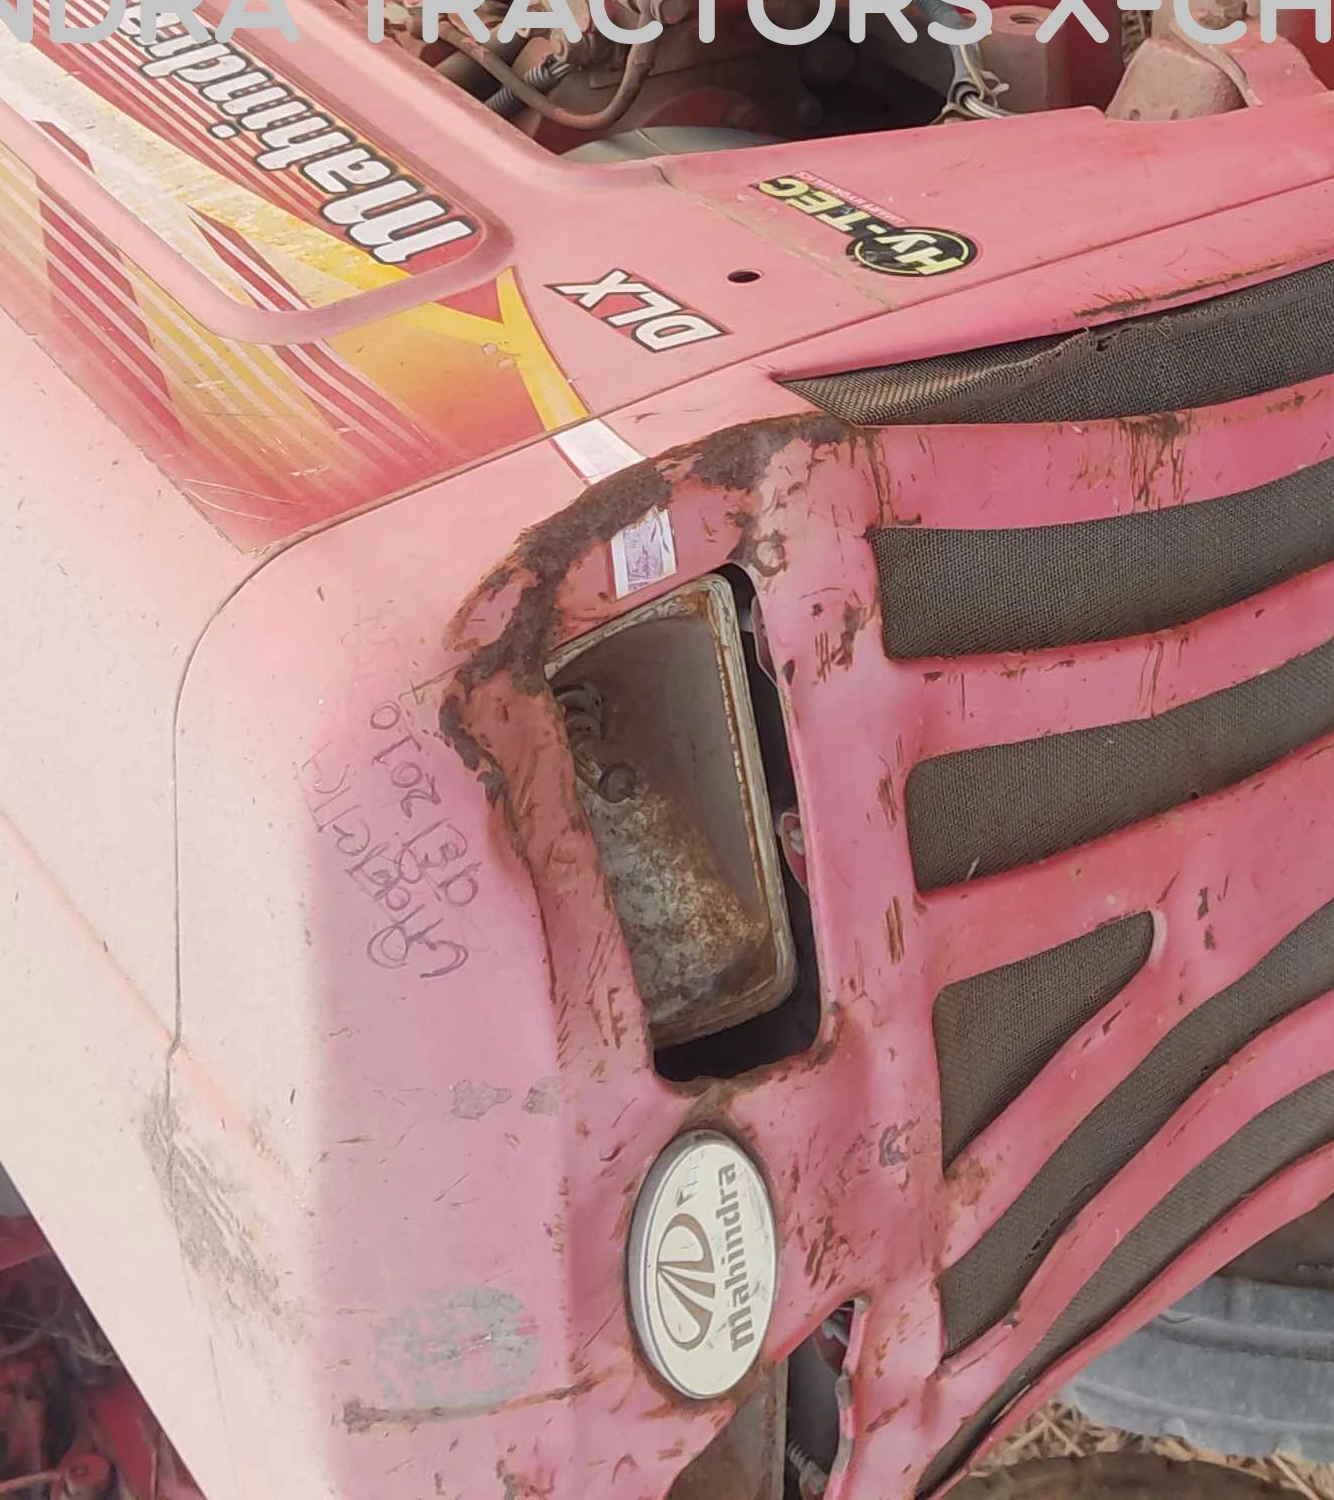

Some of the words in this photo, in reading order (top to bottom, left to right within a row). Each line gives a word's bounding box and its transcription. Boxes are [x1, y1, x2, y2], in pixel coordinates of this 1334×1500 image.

[756, 174, 966, 275] Hy-TEC
[547, 267, 727, 351] DLX
[715, 1162, 756, 1351] Mahindra
